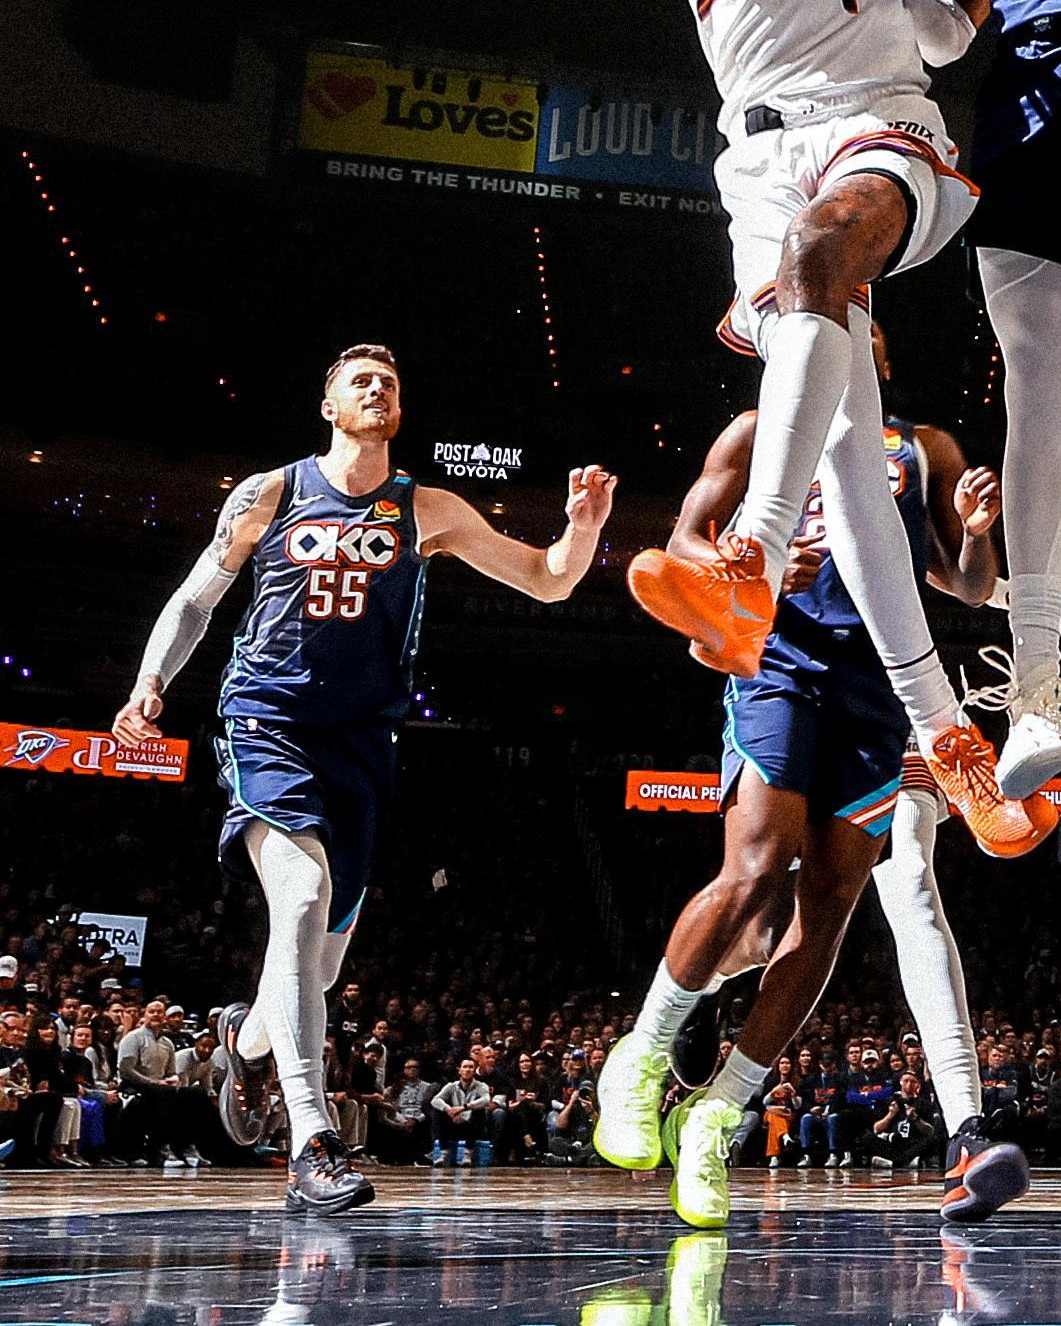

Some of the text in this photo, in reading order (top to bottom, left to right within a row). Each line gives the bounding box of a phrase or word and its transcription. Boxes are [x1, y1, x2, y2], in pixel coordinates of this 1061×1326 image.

[548, 101, 654, 163] LOUD
[326, 160, 404, 182] BRING
[411, 170, 459, 189] THE
[470, 176, 581, 201] THUNDER
[618, 192, 672, 210] EXIT
[433, 442, 523, 467] POST OAK
[444, 463, 508, 480] TOYOTA
[287, 522, 398, 568] OKC
[307, 568, 369, 618] 55
[116, 751, 183, 765] DEVAUGHN
[639, 783, 699, 800] OFFICIAL
